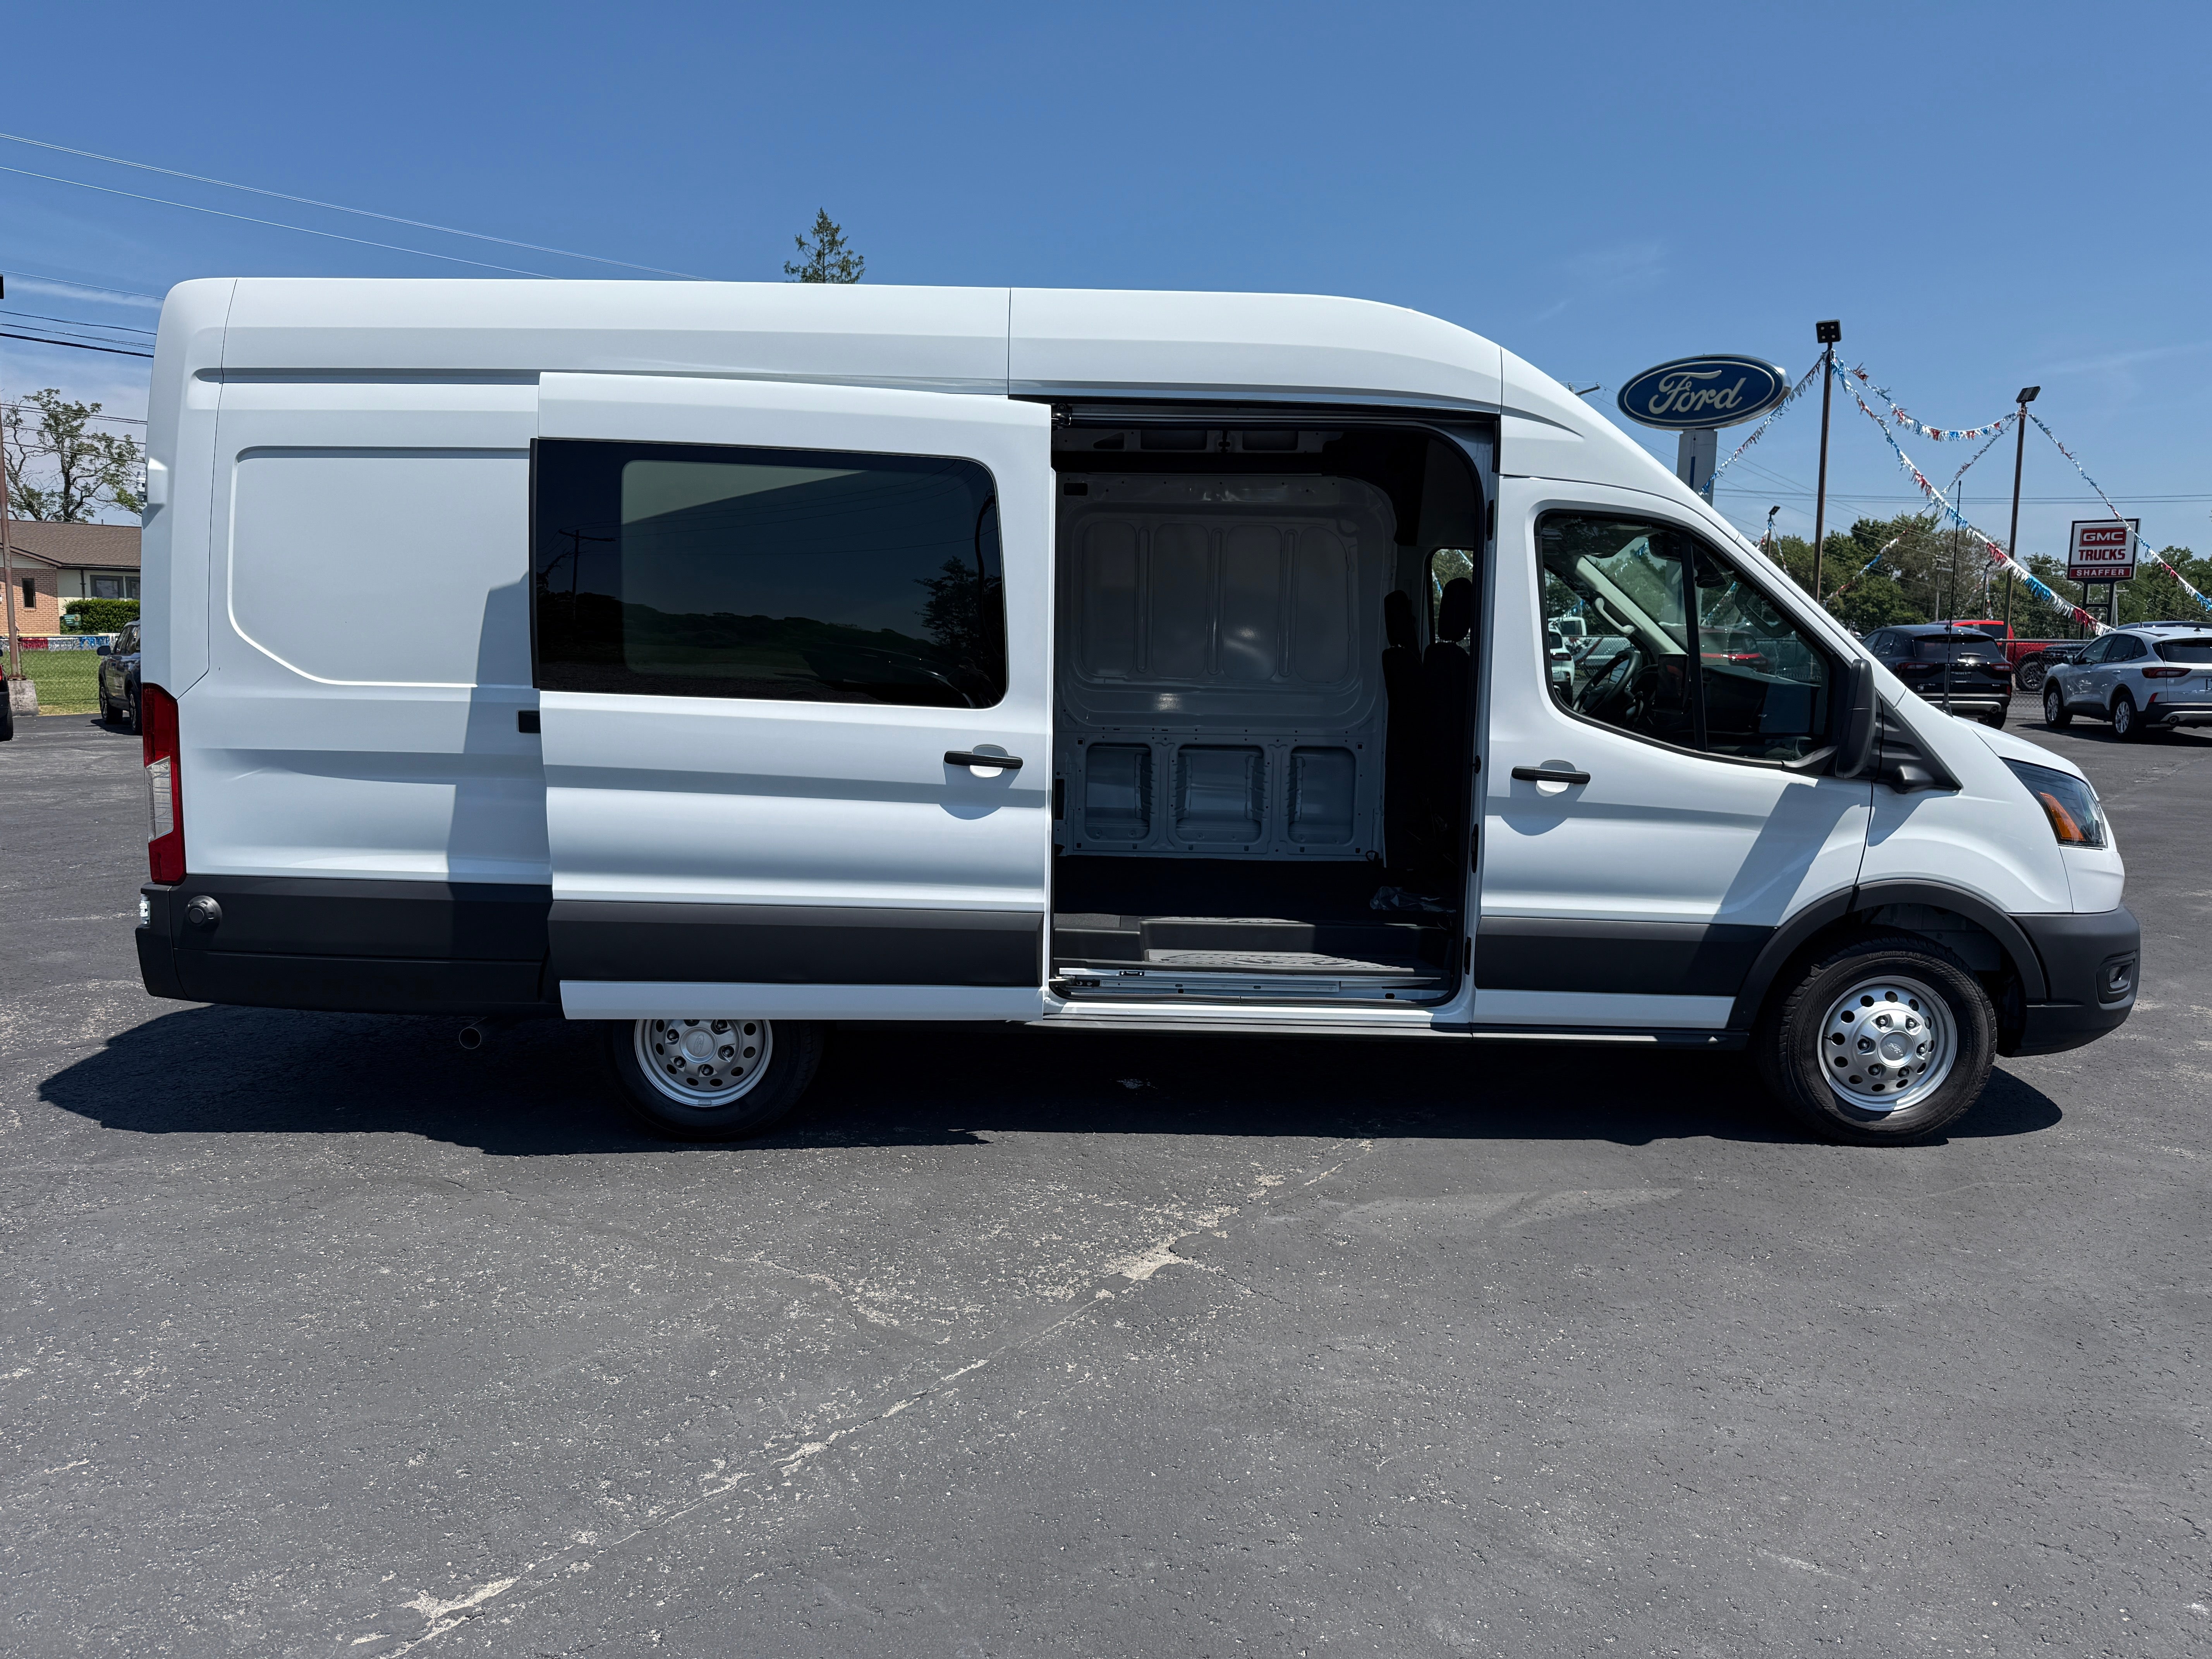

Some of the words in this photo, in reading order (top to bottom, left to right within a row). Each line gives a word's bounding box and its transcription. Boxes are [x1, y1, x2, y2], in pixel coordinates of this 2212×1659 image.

[1649, 370, 1747, 414] Ford
[2083, 532, 2123, 541] GMC
[2078, 549, 2126, 561] TRUCKS
[1867, 951, 1906, 959] VanContact
